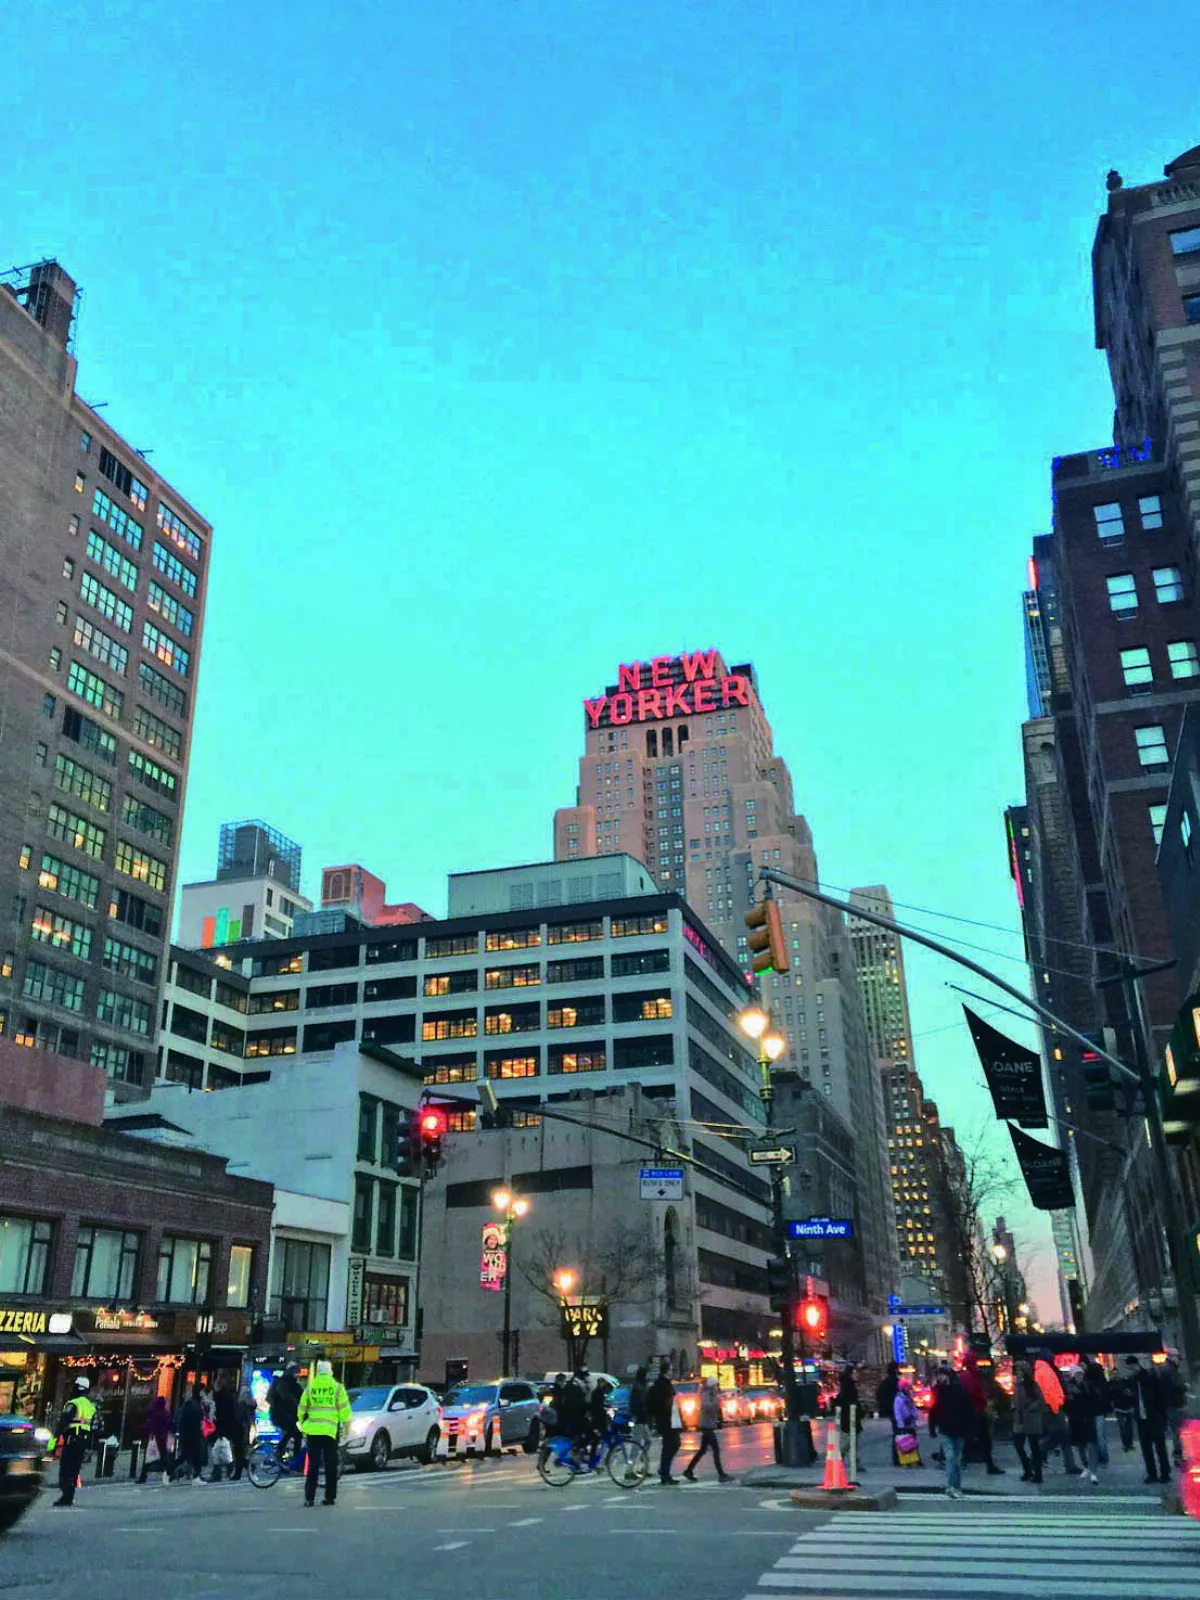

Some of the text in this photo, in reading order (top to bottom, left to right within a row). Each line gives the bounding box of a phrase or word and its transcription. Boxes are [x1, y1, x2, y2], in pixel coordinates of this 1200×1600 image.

[618, 648, 717, 692] NEW
[583, 674, 749, 728] YORKER
[990, 1061, 1034, 1073] OANE
[795, 1224, 846, 1235] Ninth Ave
[565, 1308, 603, 1321] PARK
